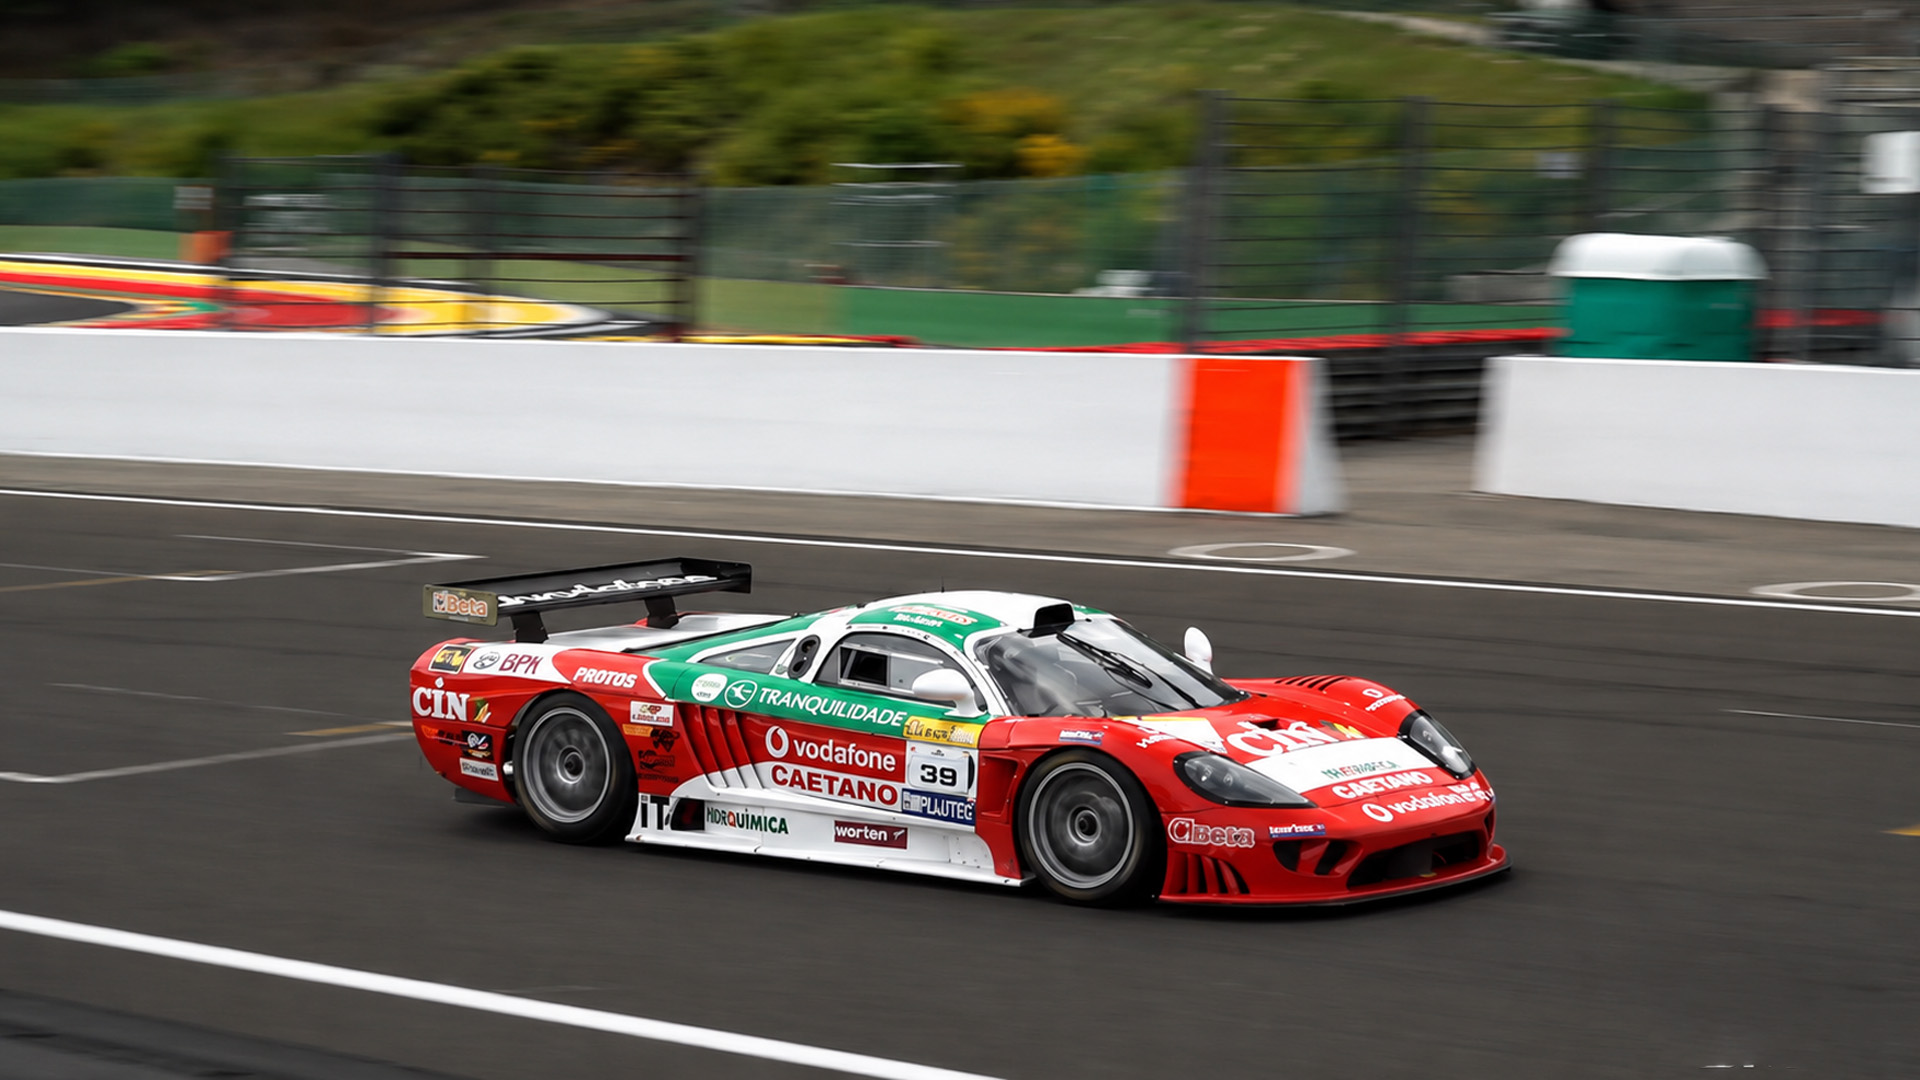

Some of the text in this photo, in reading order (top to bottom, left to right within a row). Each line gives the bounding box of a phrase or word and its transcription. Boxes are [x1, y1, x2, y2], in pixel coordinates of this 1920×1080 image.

[446, 594, 488, 617] Beta
[572, 666, 638, 689] PROTOS
[758, 687, 908, 727] TRANQUILIDADE
[793, 739, 896, 772] vodafone
[771, 764, 898, 806] CAETANO
[920, 763, 957, 787] 39
[1332, 771, 1434, 799] CAETANO
[835, 825, 888, 841] worten
